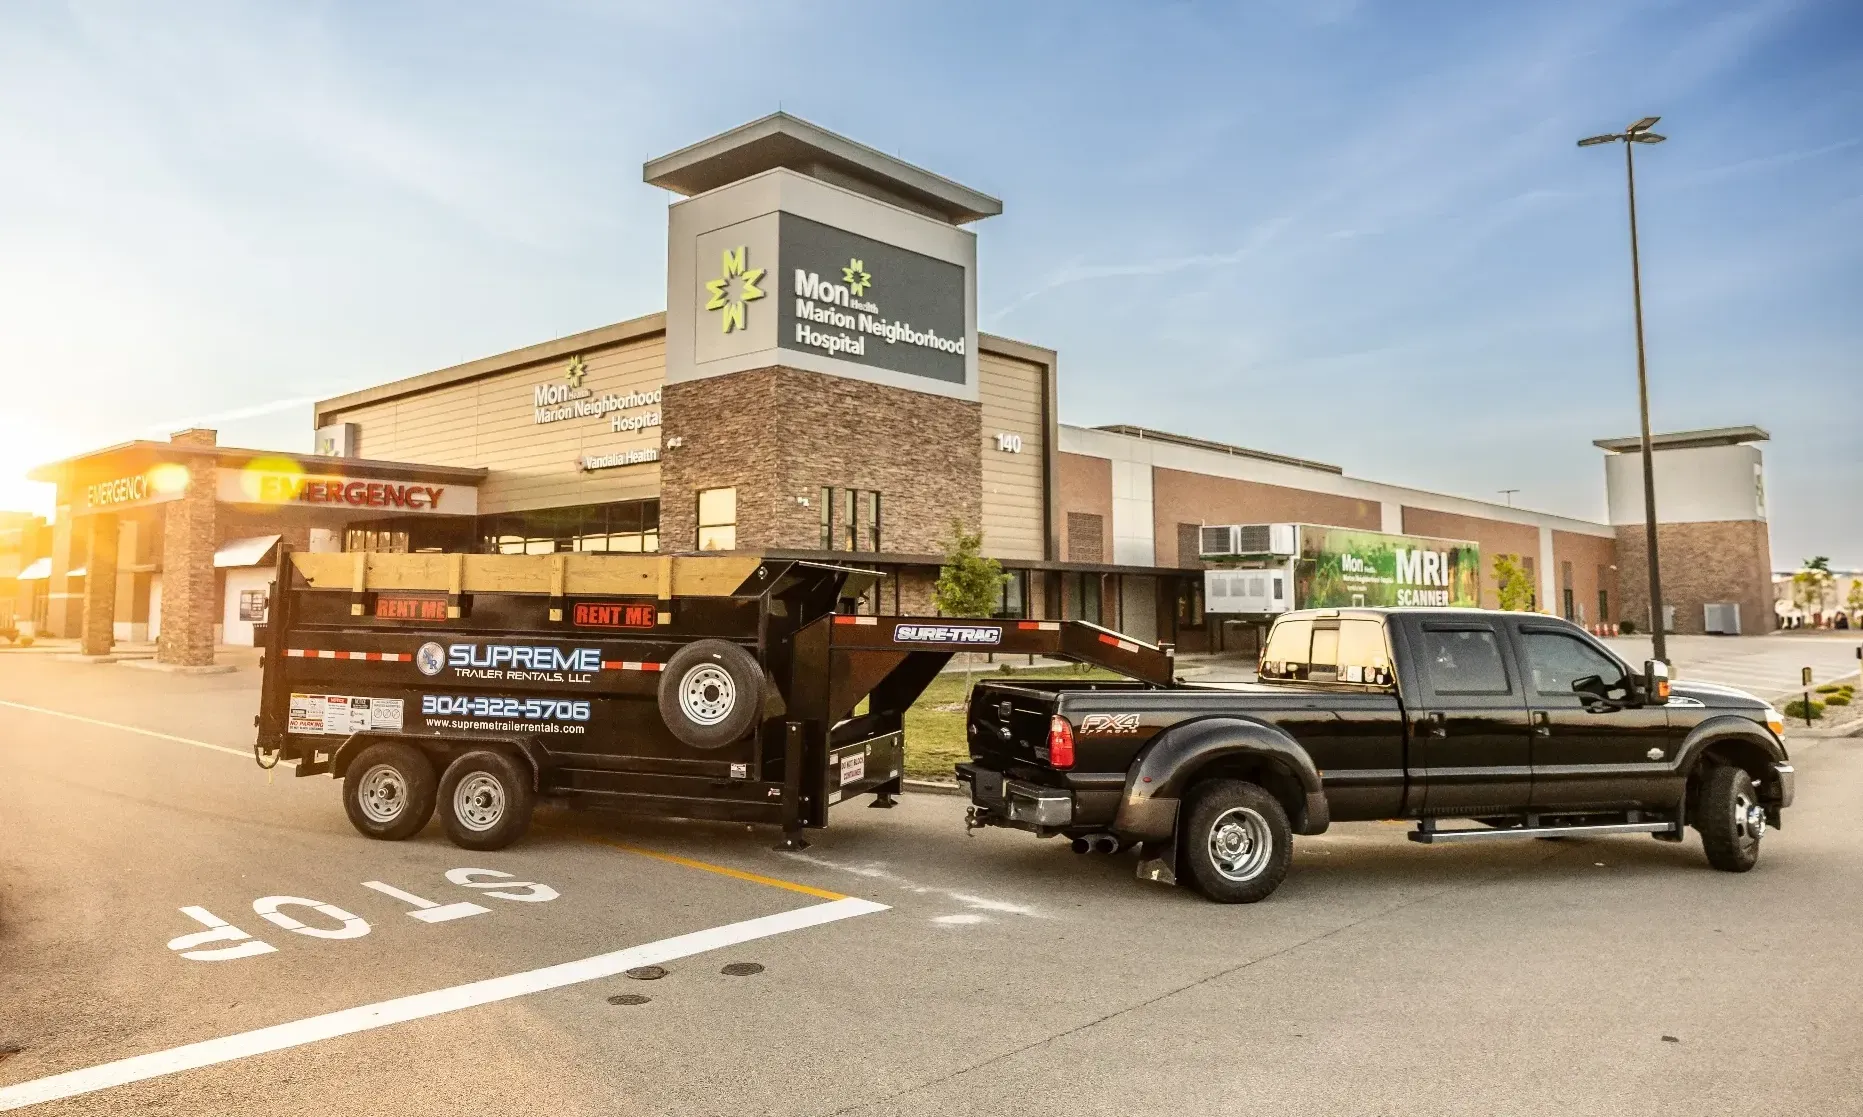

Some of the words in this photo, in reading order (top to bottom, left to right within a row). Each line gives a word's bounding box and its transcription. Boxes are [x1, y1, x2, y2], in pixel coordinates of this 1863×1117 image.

[795, 269, 849, 308] Mon
[850, 299, 879, 315] Health
[795, 298, 856, 330] Marion
[857, 312, 965, 356] Neighborhood
[795, 323, 865, 356] Hospital
[534, 383, 568, 407] Mon
[535, 406, 572, 424] Marion
[574, 384, 663, 418] Neighborhood
[611, 411, 662, 434] Hospital
[996, 433, 1022, 454] 140
[586, 455, 624, 470] Vandalia
[625, 448, 657, 466] Health
[87, 474, 149, 507] EMERGENCY
[260, 475, 444, 509] EMERGENCY
[1341, 553, 1364, 573] Mon
[1395, 548, 1449, 586] MRI
[376, 600, 416, 618] RENT
[421, 601, 446, 619] ME
[1397, 589, 1449, 607] SCANNER
[575, 604, 621, 624] RENT
[625, 606, 652, 626] ME
[897, 626, 999, 643] SURE-TRAC
[448, 644, 601, 672] SUPREME
[454, 668, 503, 680] TRAILER
[506, 671, 564, 683] RENTALS,
[568, 674, 592, 683] LLC
[421, 694, 591, 721] 304-322-5706
[425, 718, 585, 734] www.supremetrailerrentals.com
[1080, 713, 1140, 730] FX4
[167, 867, 561, 962] STOP
